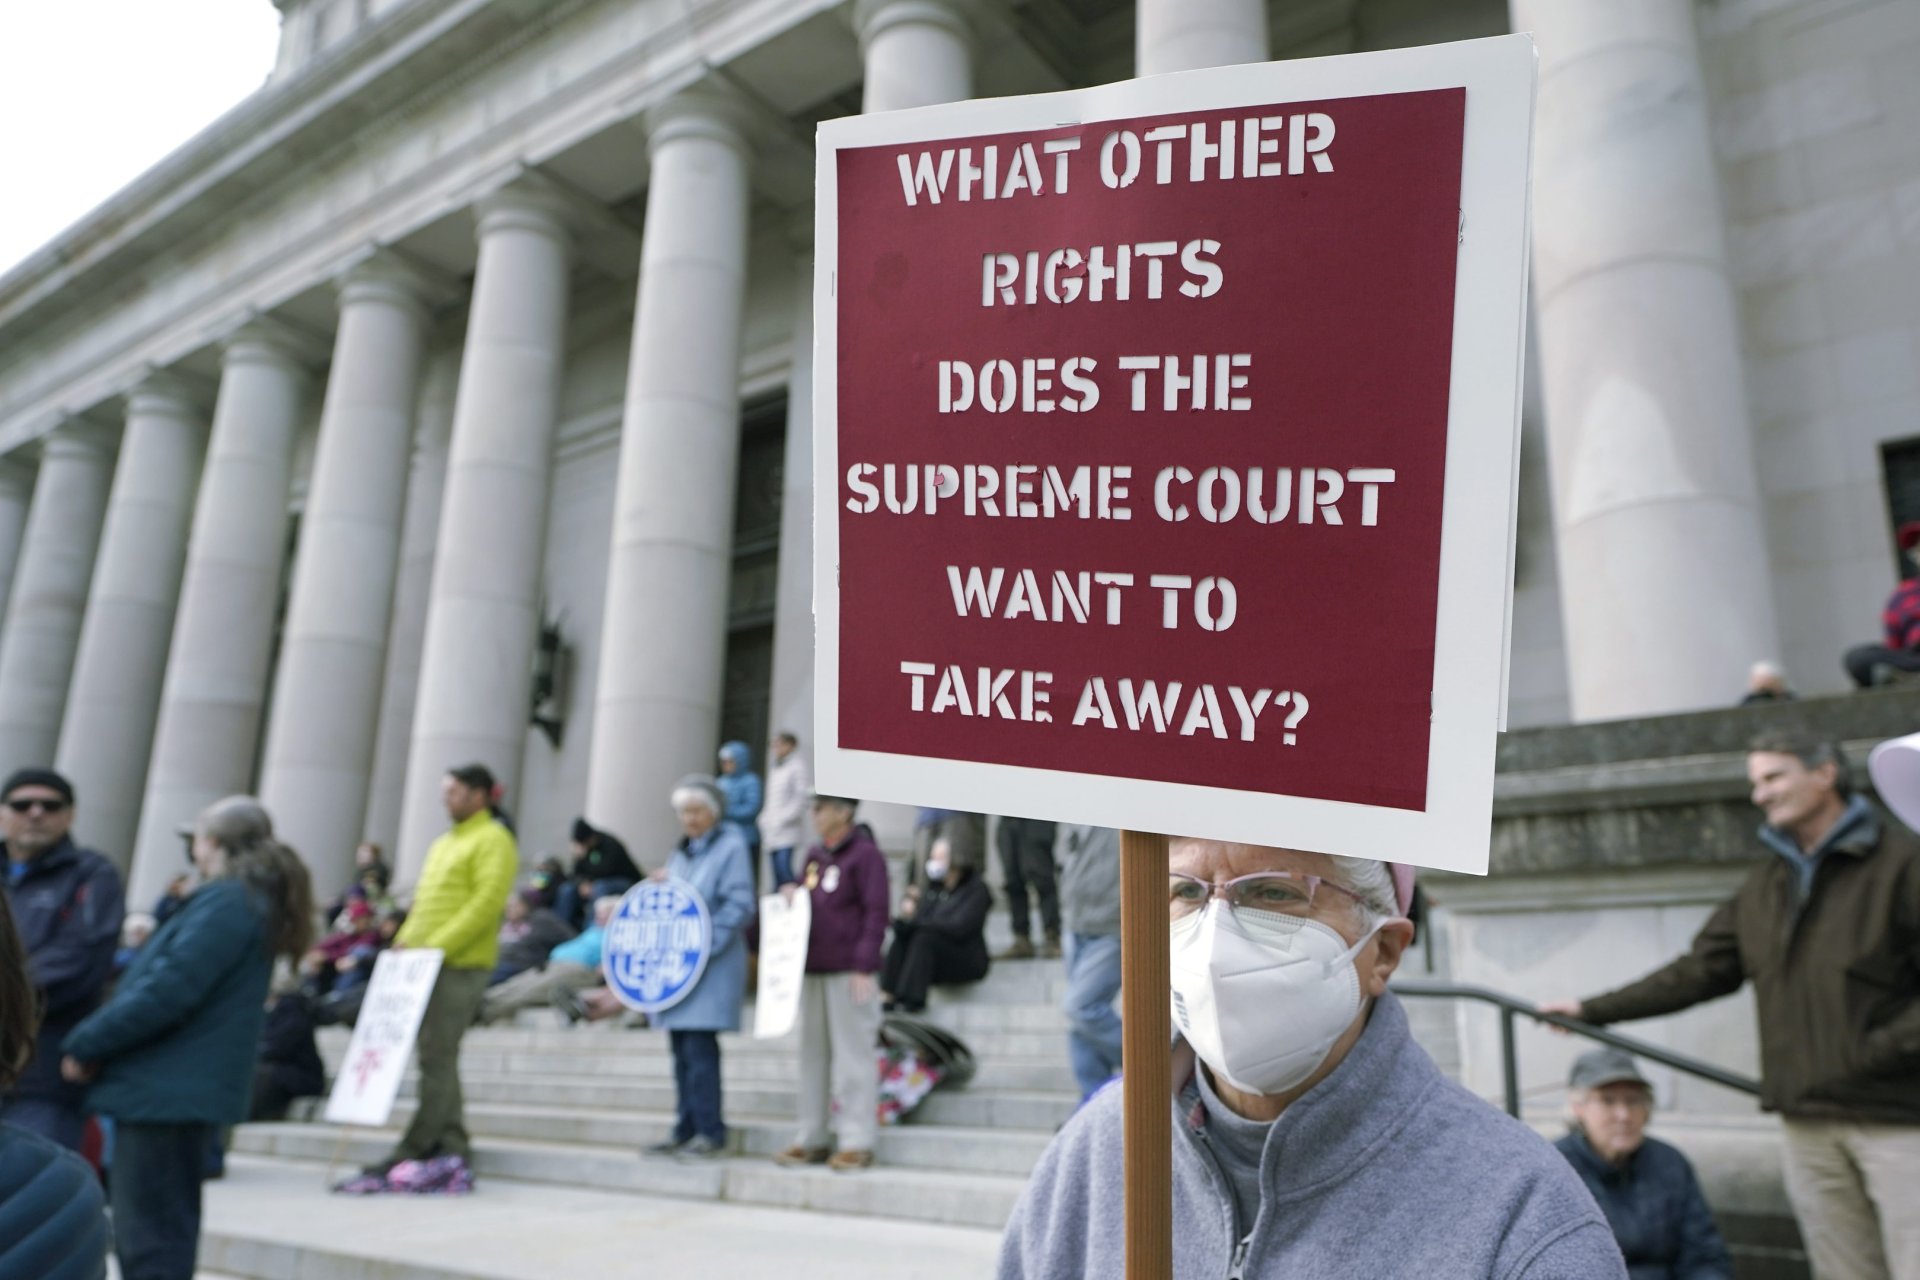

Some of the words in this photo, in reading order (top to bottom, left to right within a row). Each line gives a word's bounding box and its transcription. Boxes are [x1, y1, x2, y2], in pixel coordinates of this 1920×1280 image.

[896, 135, 1082, 207] WHAT
[1099, 112, 1336, 190] OTHER
[981, 238, 1224, 307] RIGHTS
[938, 356, 1100, 414] DOES
[1118, 353, 1252, 412] THE
[846, 462, 1133, 521] SUPREME
[1153, 465, 1396, 527] COURT
[946, 564, 1134, 626] WANT
[1149, 573, 1238, 632] TO
[900, 660, 1054, 724] TAKE
[1071, 676, 1310, 747] AWAY?
